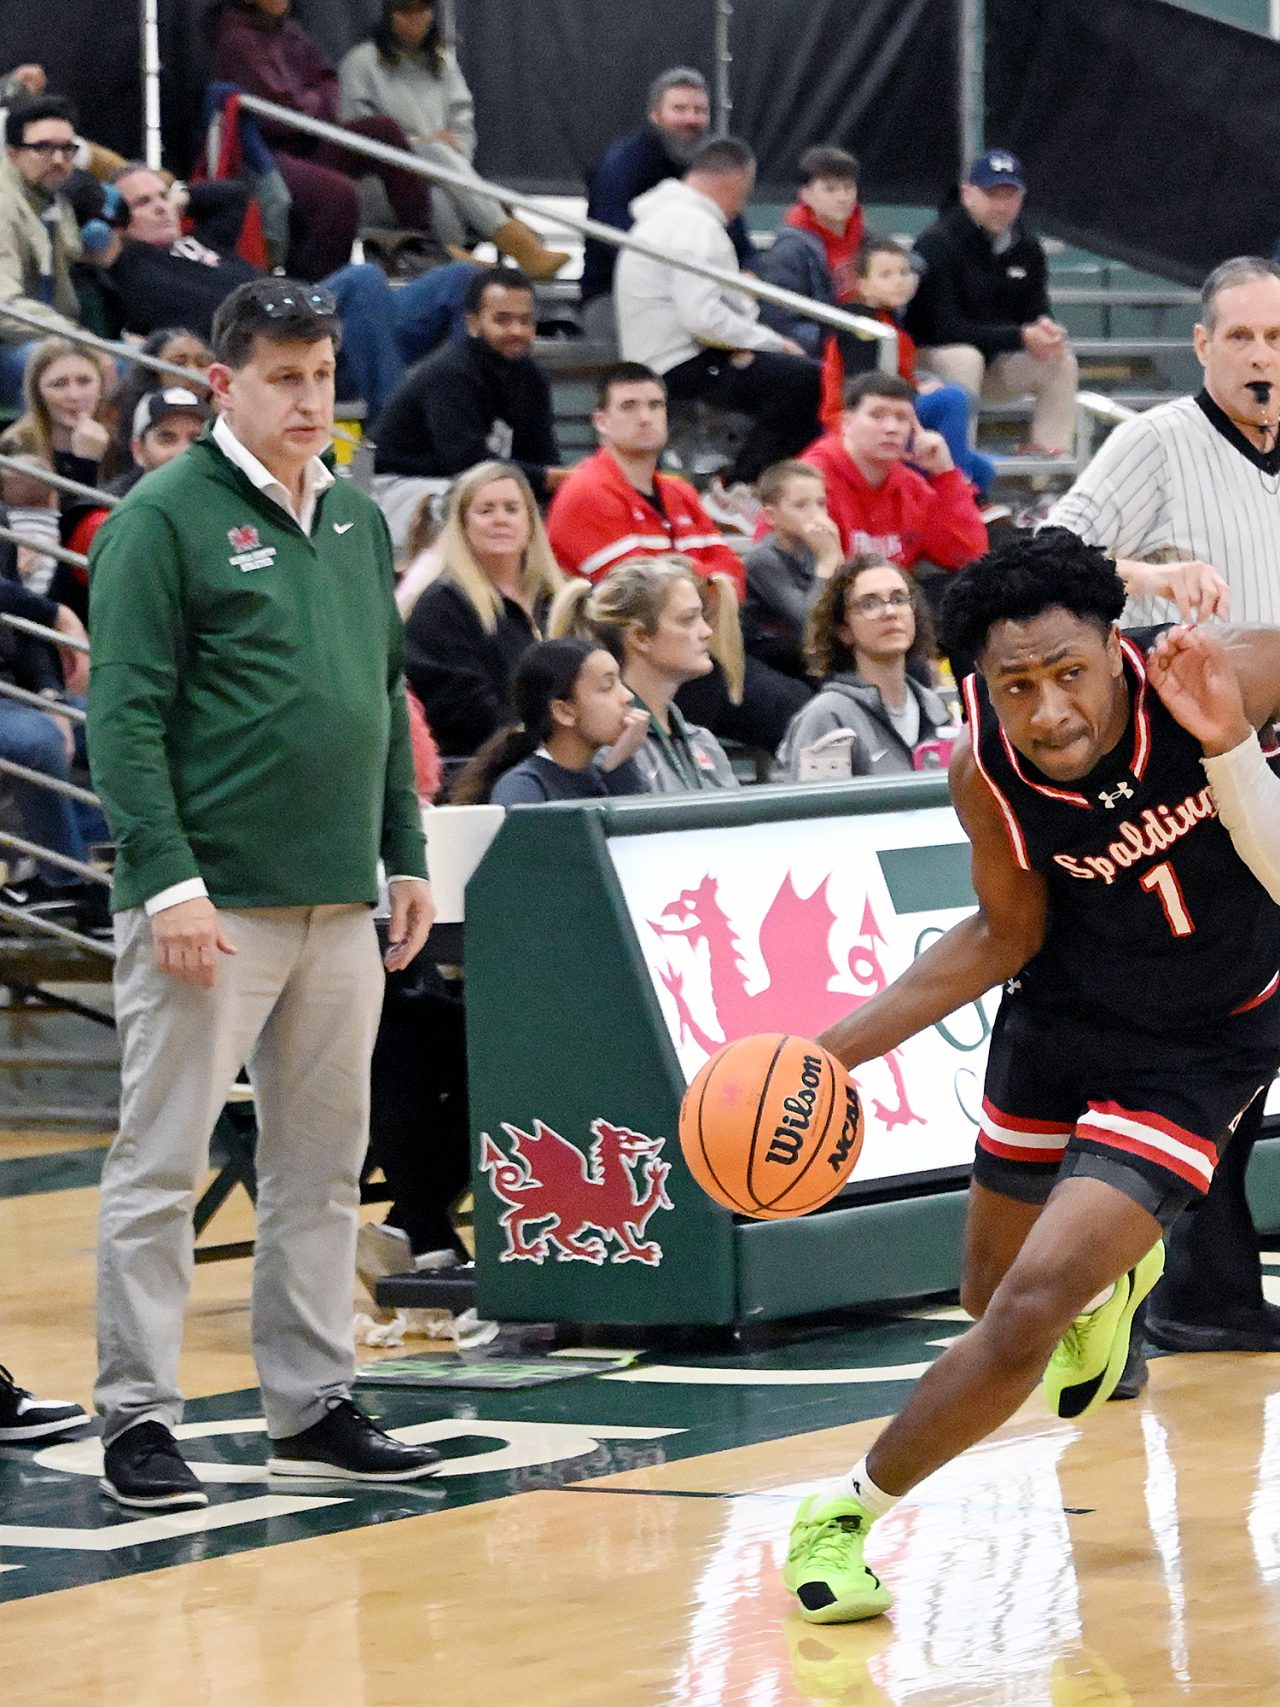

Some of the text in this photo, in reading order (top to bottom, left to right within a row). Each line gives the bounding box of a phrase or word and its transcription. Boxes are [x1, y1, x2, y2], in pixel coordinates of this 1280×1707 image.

[1138, 859, 1197, 938] 1
[764, 1055, 822, 1166] Wilson
[827, 1085, 861, 1173] NCAA
